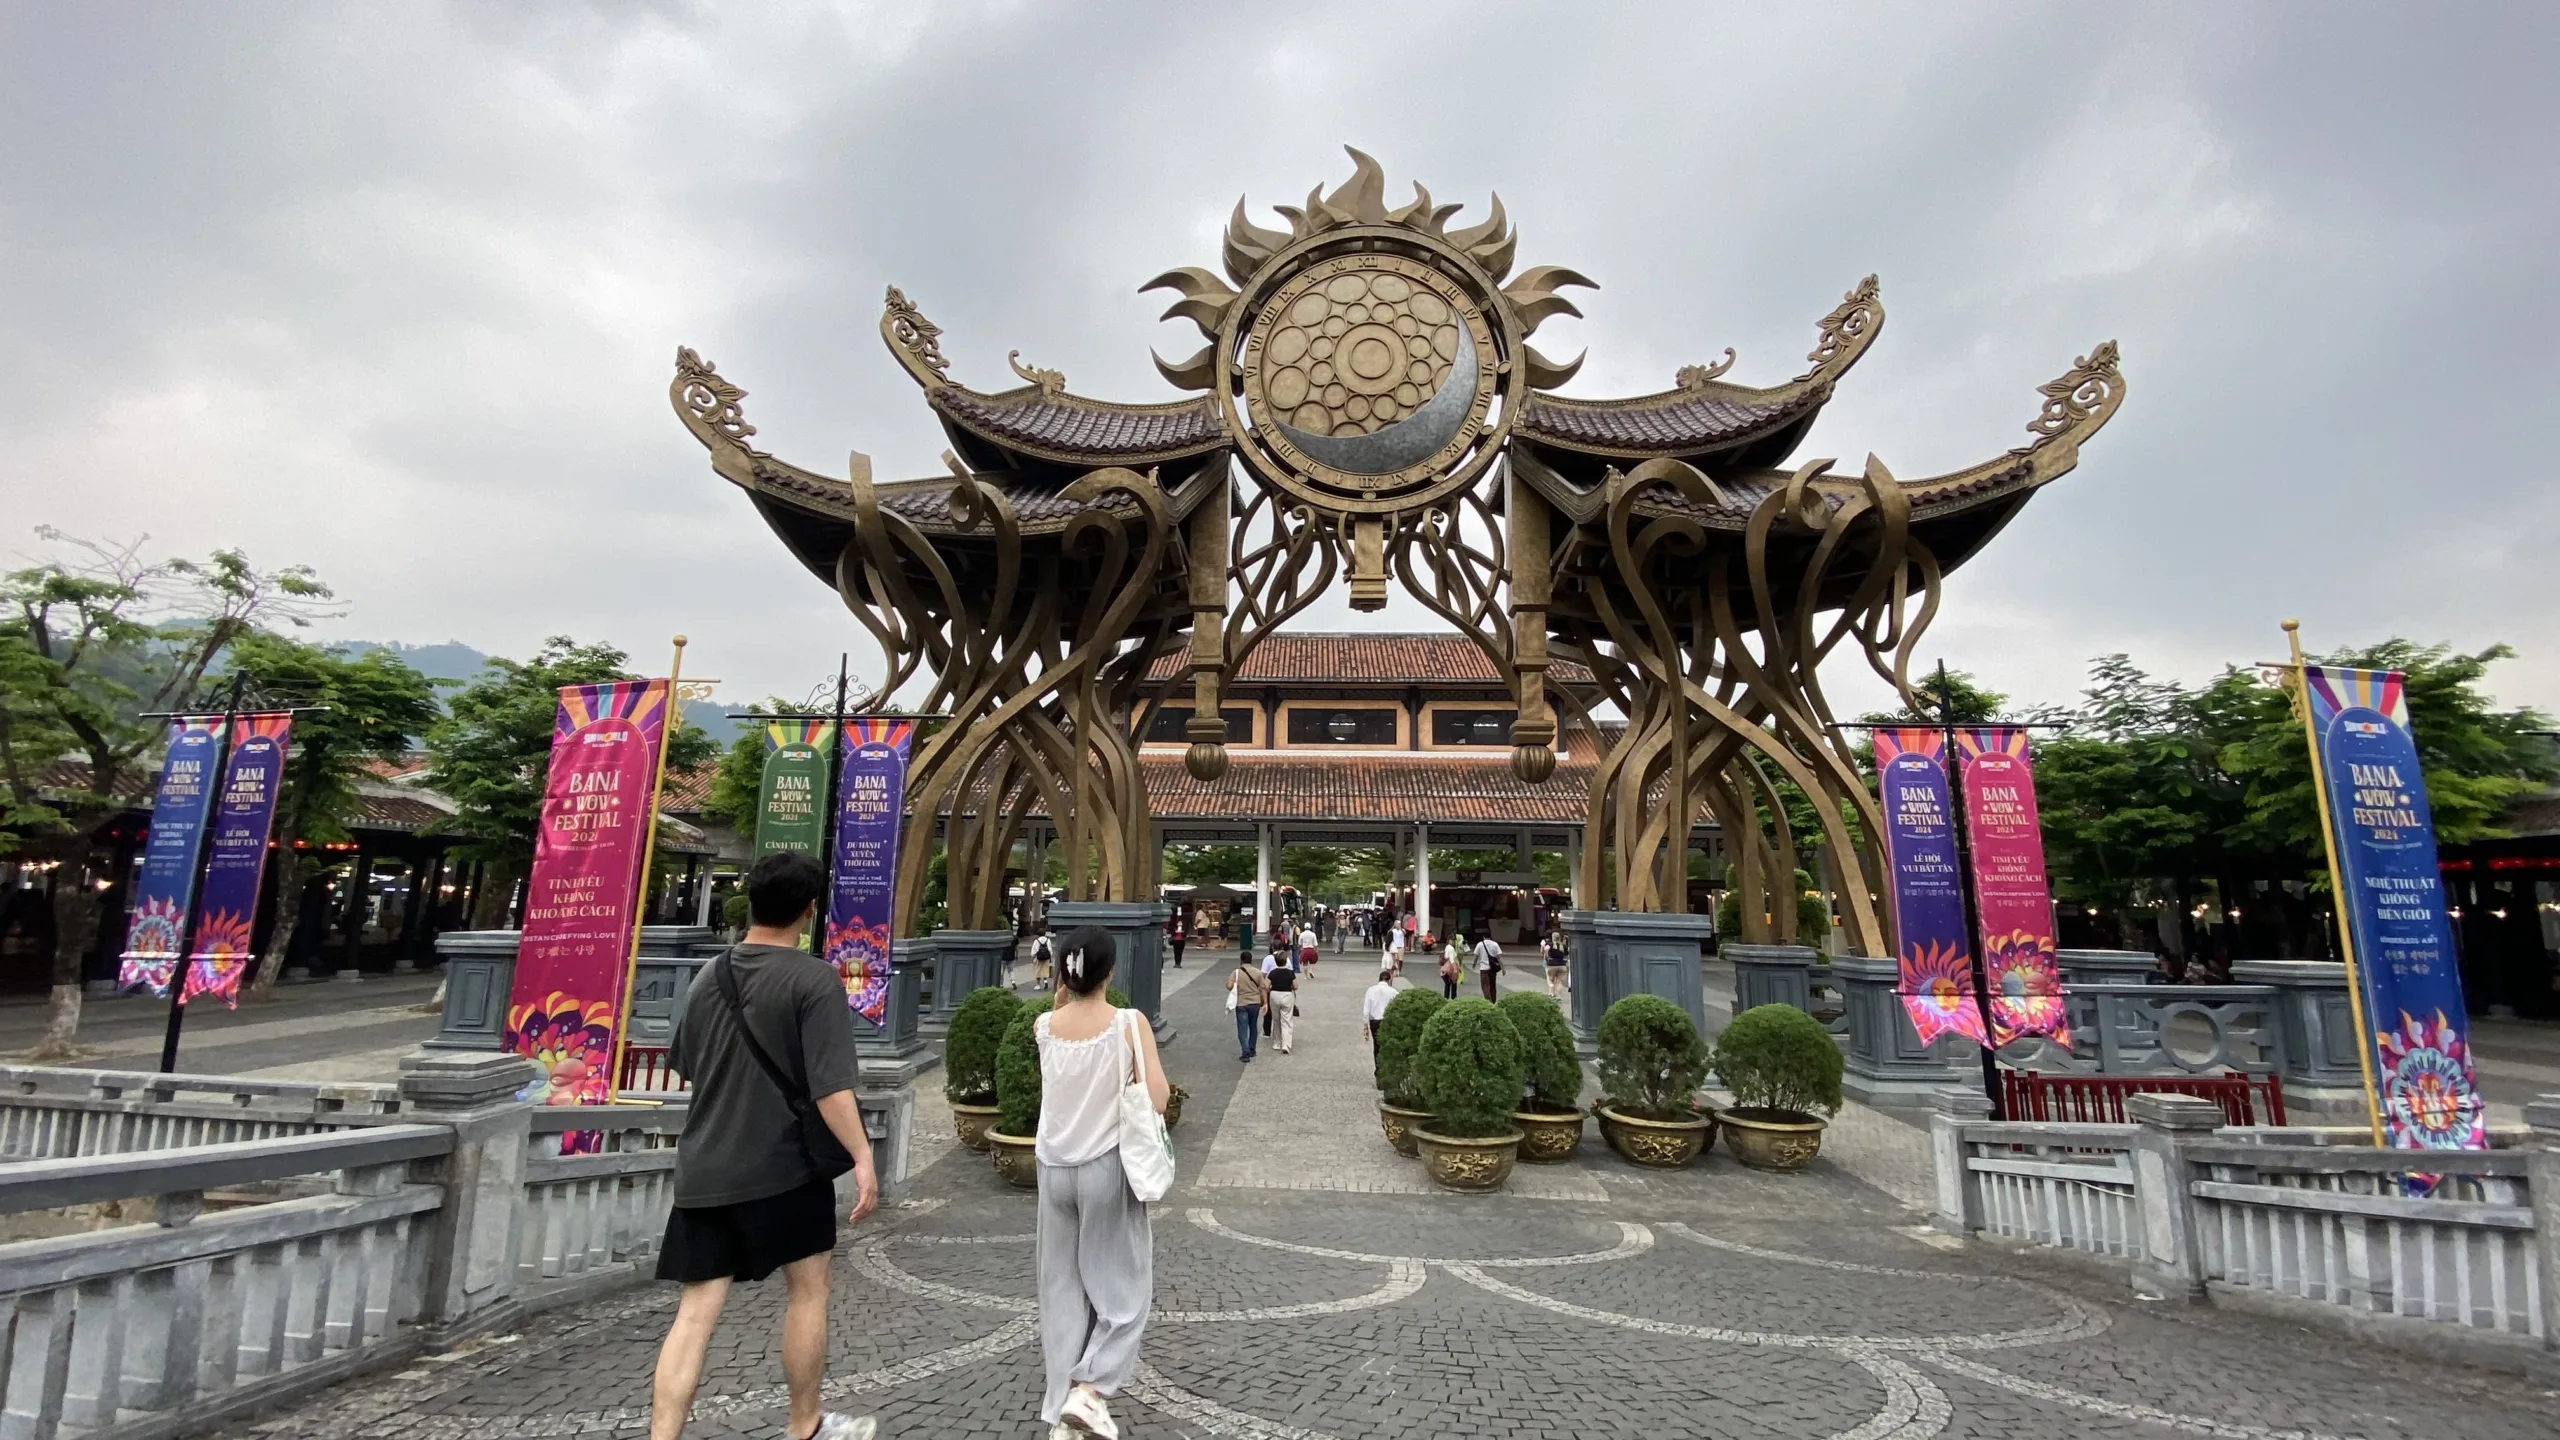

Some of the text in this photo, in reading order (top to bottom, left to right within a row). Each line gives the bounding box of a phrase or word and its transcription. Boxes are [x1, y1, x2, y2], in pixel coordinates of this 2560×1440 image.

[2347, 763, 2403, 788] BANA
[776, 776, 811, 790] BANA
[855, 776, 887, 790] BANA
[781, 791, 805, 802] WOW
[859, 790, 881, 801] WOW
[2360, 789, 2395, 807] WOW
[576, 794, 611, 811] WOW
[768, 802, 813, 813] FESTIVAL
[846, 801, 891, 813] FESTIVAL
[1907, 803, 1932, 813] WOW
[1990, 803, 2014, 813] WOW
[553, 811, 621, 831] FESTIVAL
[1897, 814, 1946, 826] FESTIVAL
[1980, 814, 2030, 826] FESTIVAL
[2352, 807, 2422, 827] FESTIVAL
